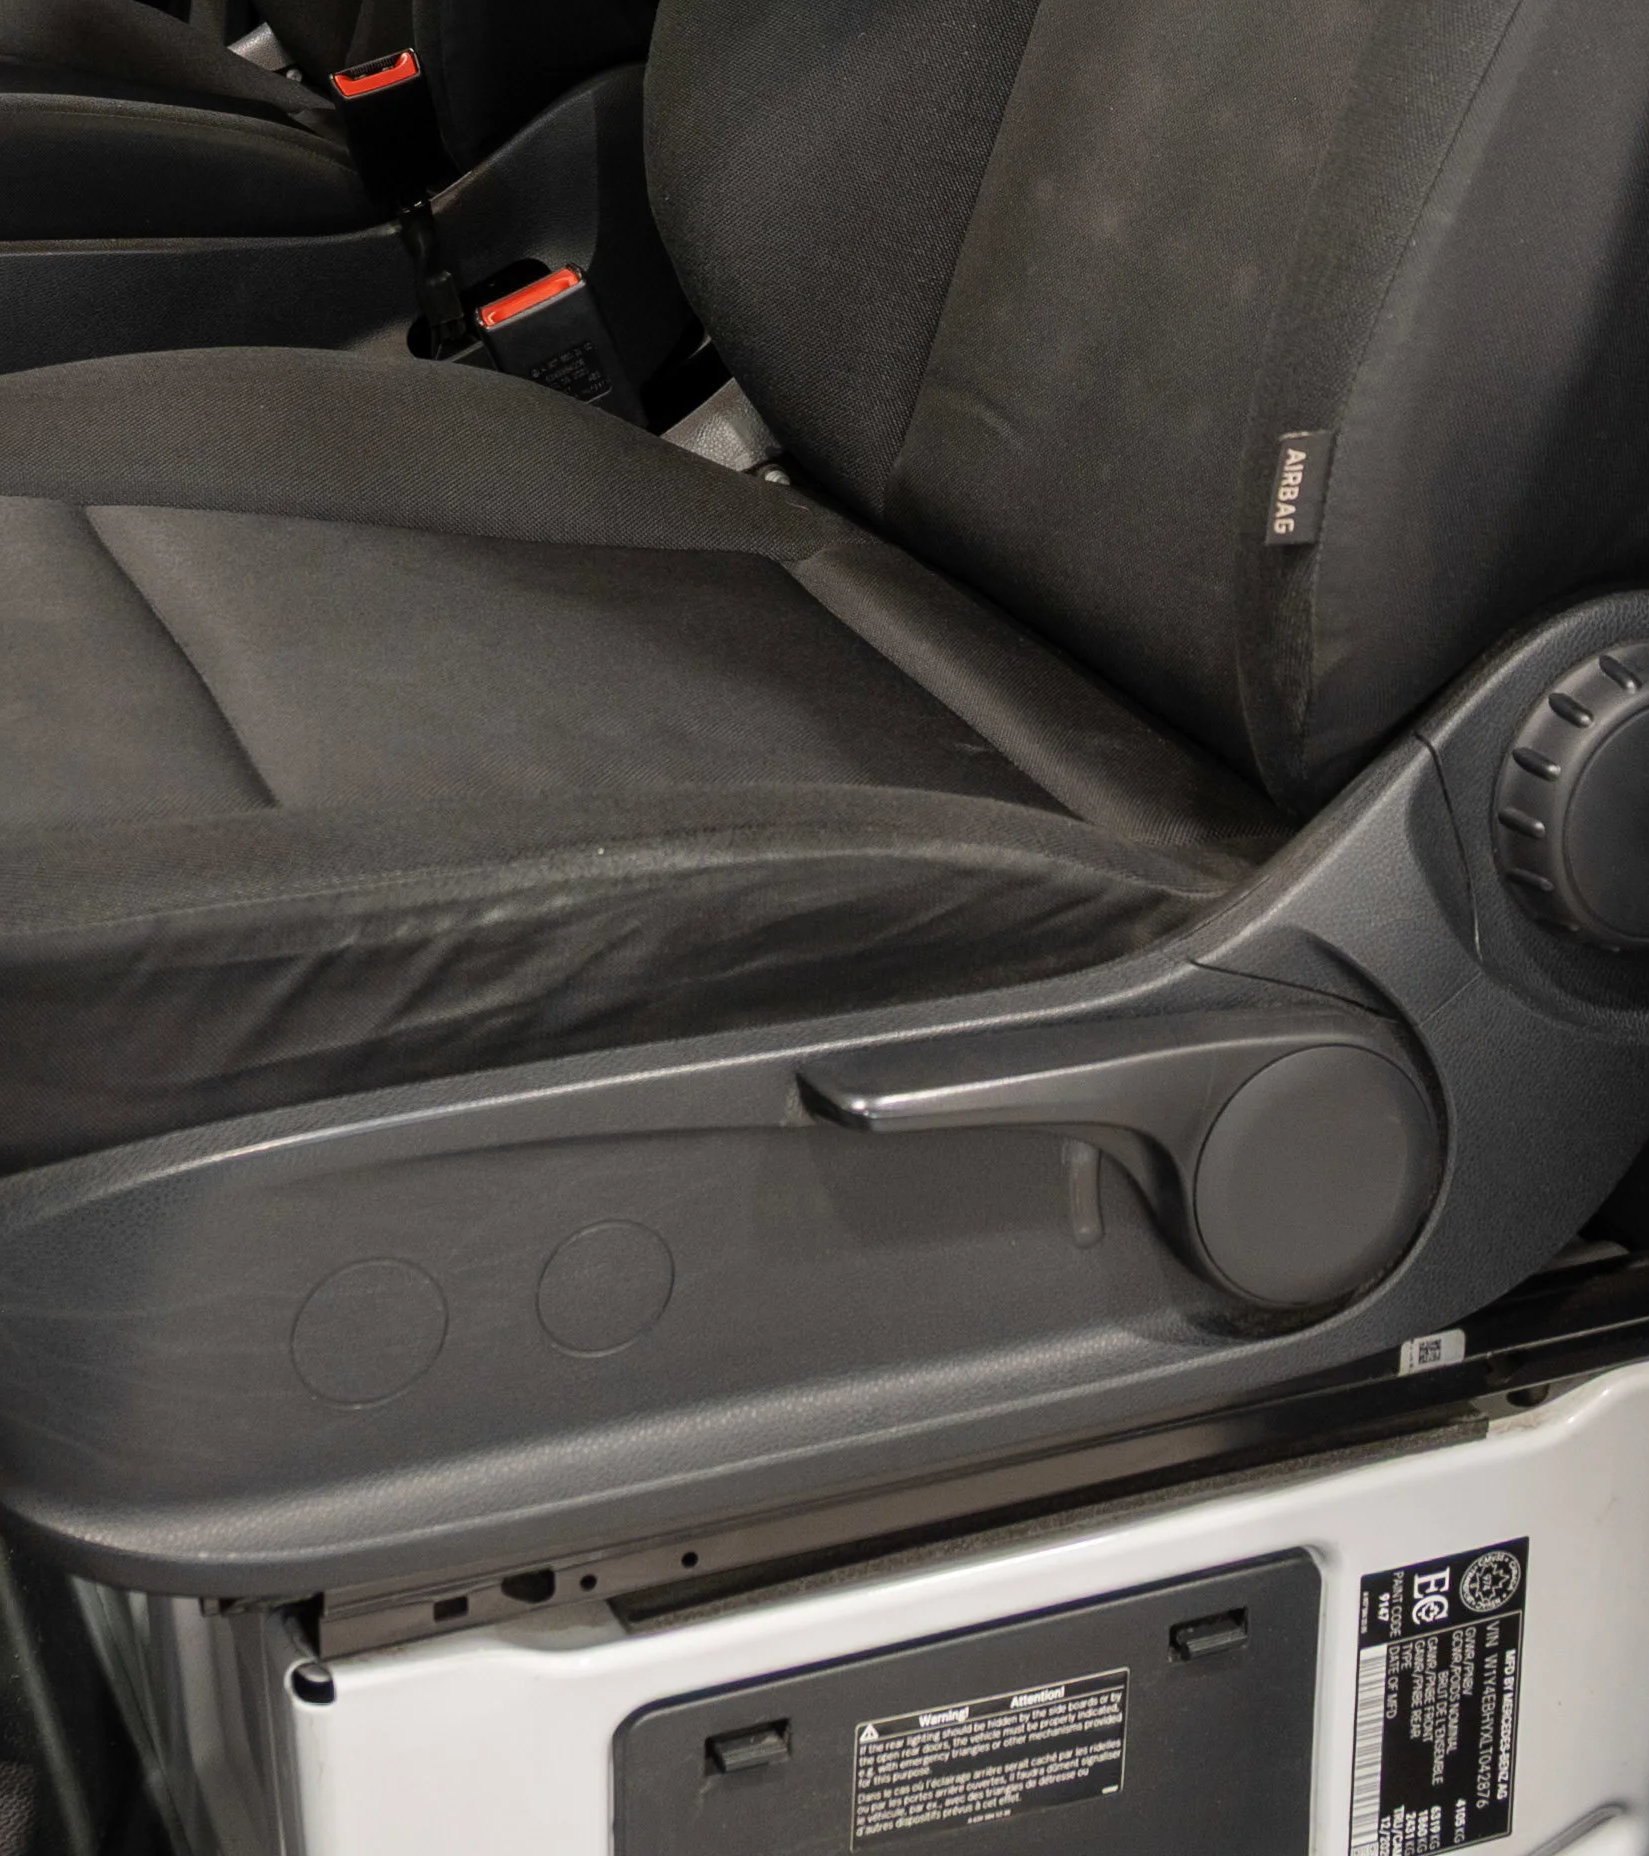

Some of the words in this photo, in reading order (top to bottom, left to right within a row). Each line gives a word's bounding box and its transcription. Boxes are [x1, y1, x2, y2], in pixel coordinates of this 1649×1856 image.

[1272, 447, 1307, 535] AIRBAG
[1391, 1570, 1403, 1605] PAINT
[1377, 1592, 1389, 1623] 9147
[1389, 1604, 1402, 1638] CODE
[1485, 1620, 1499, 1647] VIN
[1387, 1645, 1399, 1675] DATE
[1401, 1642, 1412, 1670] TYPE
[1423, 1635, 1437, 1705] GAWR/PNBE
[1461, 1625, 1476, 1697] GVWR/PNBV
[1503, 1648, 1516, 1676] MFD
[1387, 1675, 1398, 1692] OF
[1410, 1638, 1425, 1708] GAWR/PNBE
[1436, 1670, 1448, 1700] BRUT
[1502, 1675, 1514, 1692] BY
[918, 1705, 969, 1730] Warning!
[1009, 1685, 1065, 1709] Attention!
[1385, 1693, 1397, 1719] MFD
[1435, 1700, 1446, 1717] DE
[1409, 1708, 1421, 1739] REAR
[1421, 1705, 1434, 1744] FRONT
[1445, 1701, 1459, 1754] NOMINAL
[1475, 1653, 1498, 1809] W1Y4EBHYXLT042876
[1497, 1691, 1513, 1782] MERCEDES-BENZ
[1496, 1782, 1507, 1800] AG
[1404, 1811, 1416, 1839] 2431
[1429, 1804, 1441, 1834] 6319
[1454, 1796, 1466, 1827] 4105
[1378, 1814, 1392, 1856] 12/202
[1403, 1839, 1415, 1856] KG
[1416, 1836, 1427, 1854] KG
[1428, 1833, 1439, 1850] KG
[1453, 1826, 1464, 1844] KG
